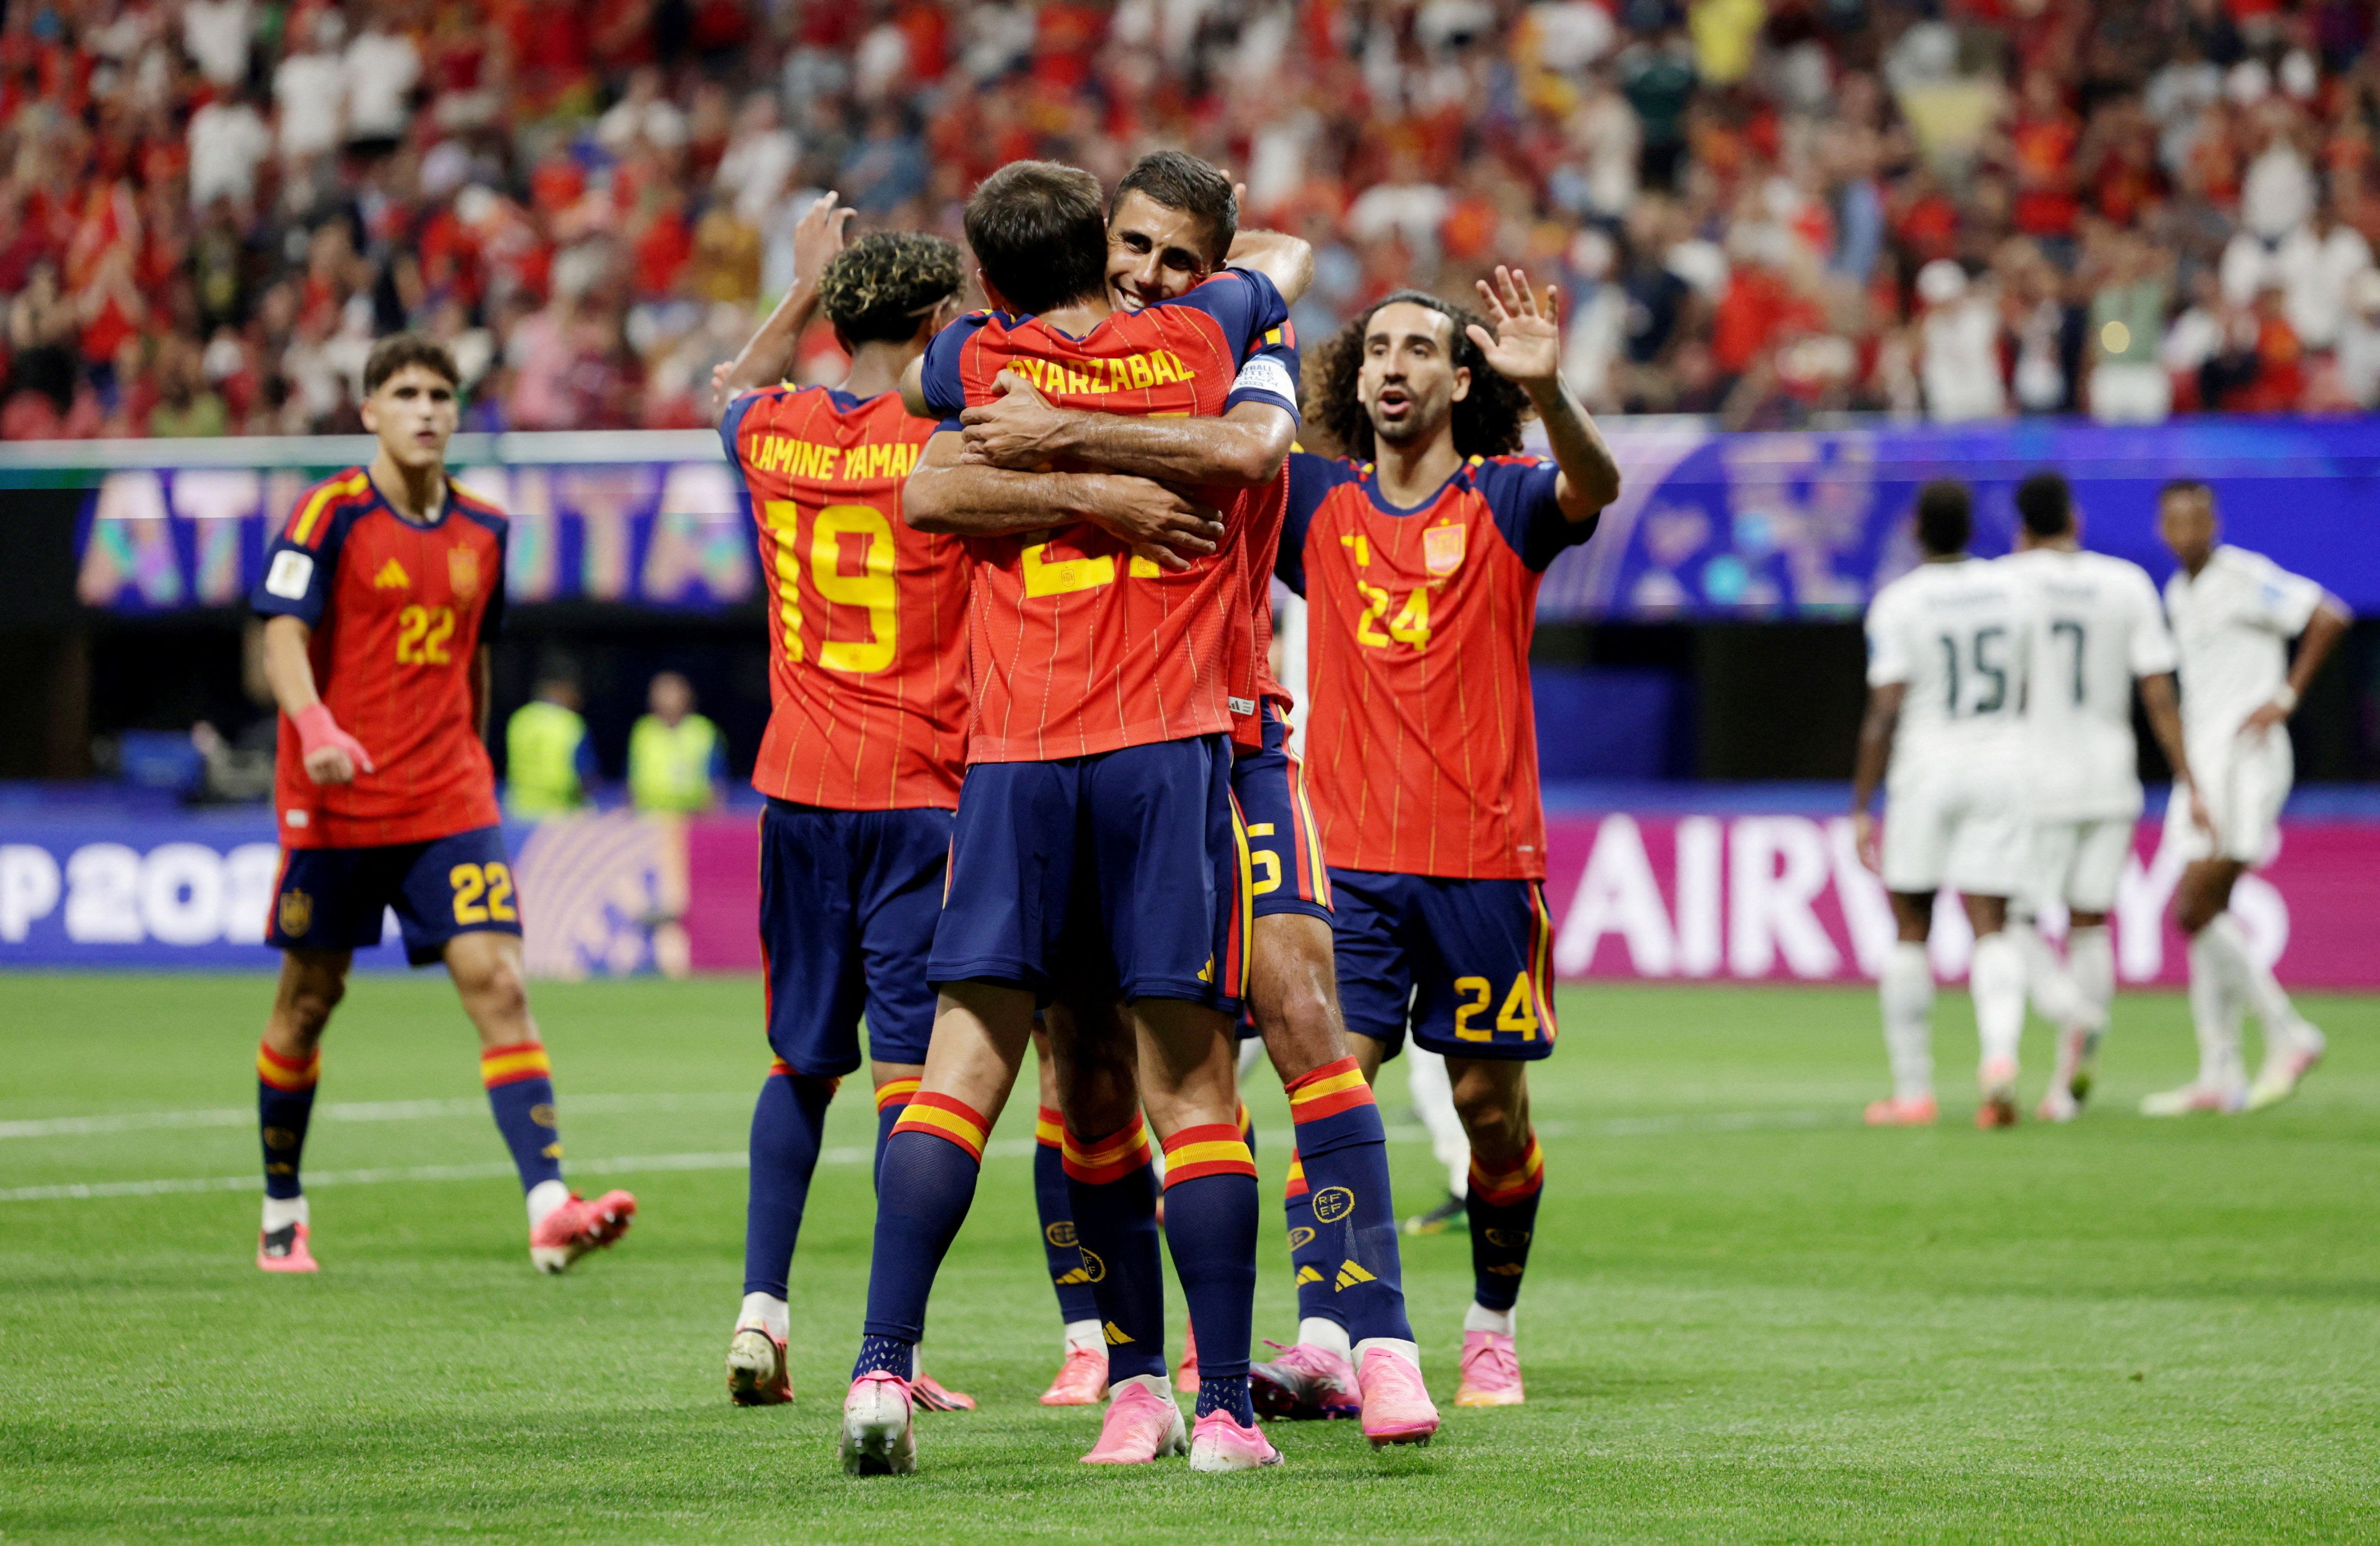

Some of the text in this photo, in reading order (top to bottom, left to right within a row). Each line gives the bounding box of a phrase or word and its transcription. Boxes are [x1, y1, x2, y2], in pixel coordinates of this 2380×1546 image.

[751, 434, 840, 480] LAMINE
[765, 500, 897, 672] 19
[1356, 580, 1431, 651] 24
[397, 605, 455, 665] 22
[1940, 626, 2008, 714] 15
[2051, 619, 2086, 705] 7
[65, 842, 280, 945] 202
[449, 862, 516, 925] 22
[1454, 970, 1539, 1042] 24
